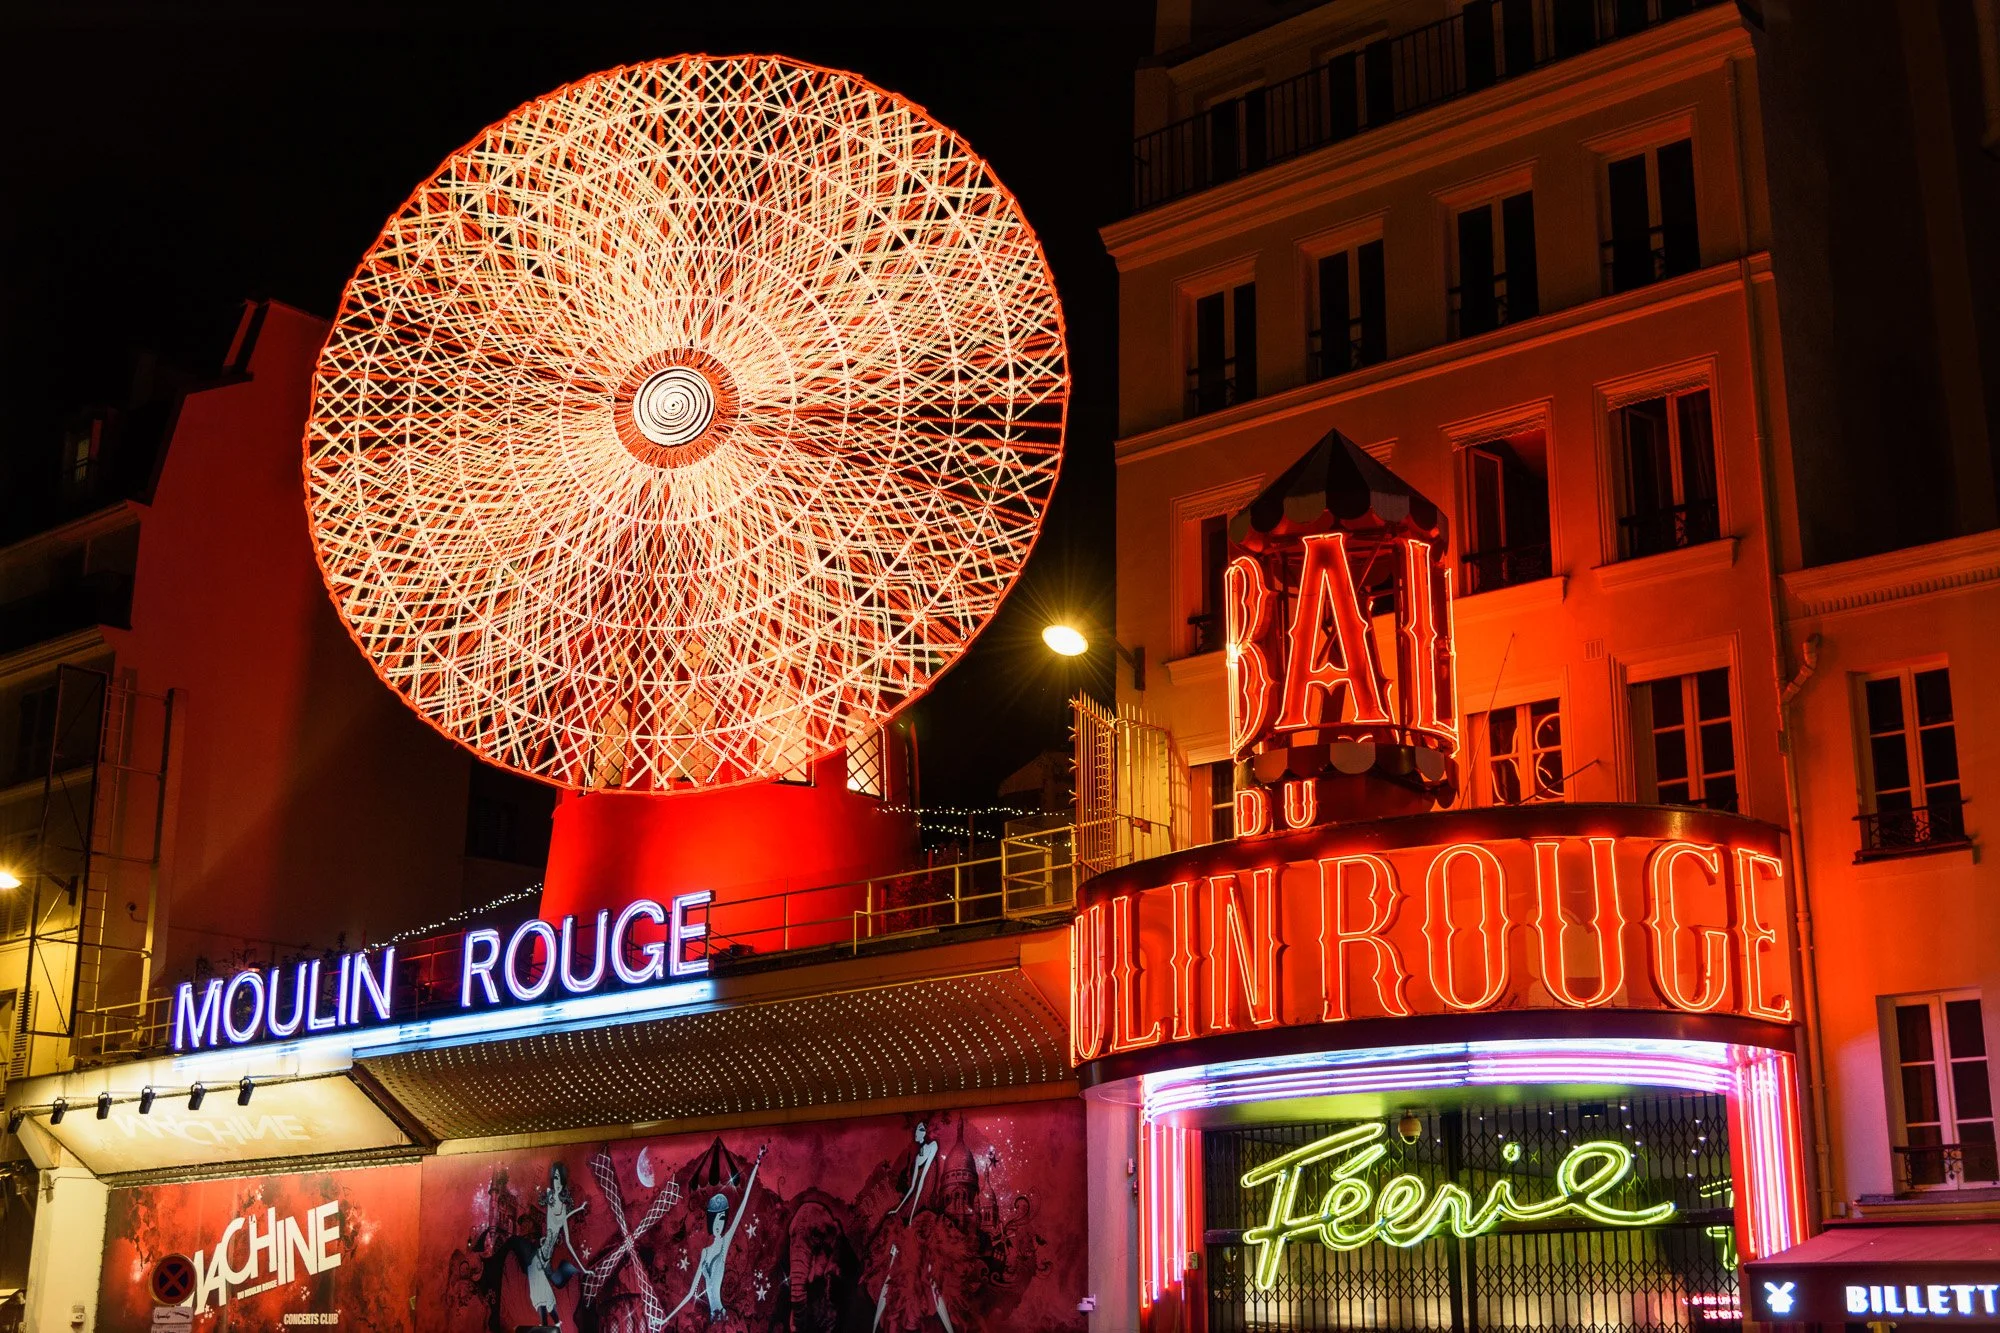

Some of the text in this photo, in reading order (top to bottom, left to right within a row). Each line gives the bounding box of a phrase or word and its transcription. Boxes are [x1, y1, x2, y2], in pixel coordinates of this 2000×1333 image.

[1225, 533, 1460, 758] BAL
[1235, 780, 1314, 837] DU
[174, 889, 714, 1049] MOULIN ROUGE
[1071, 837, 1793, 1067] ULIN ROUGE
[180, 1200, 342, 1316] MACHINE
[249, 1213, 257, 1224] LA
[1240, 1122, 1676, 1291] Féerie
[284, 1313, 339, 1325] CONCERTS CLUB
[1845, 1284, 2000, 1316] BILLETT
